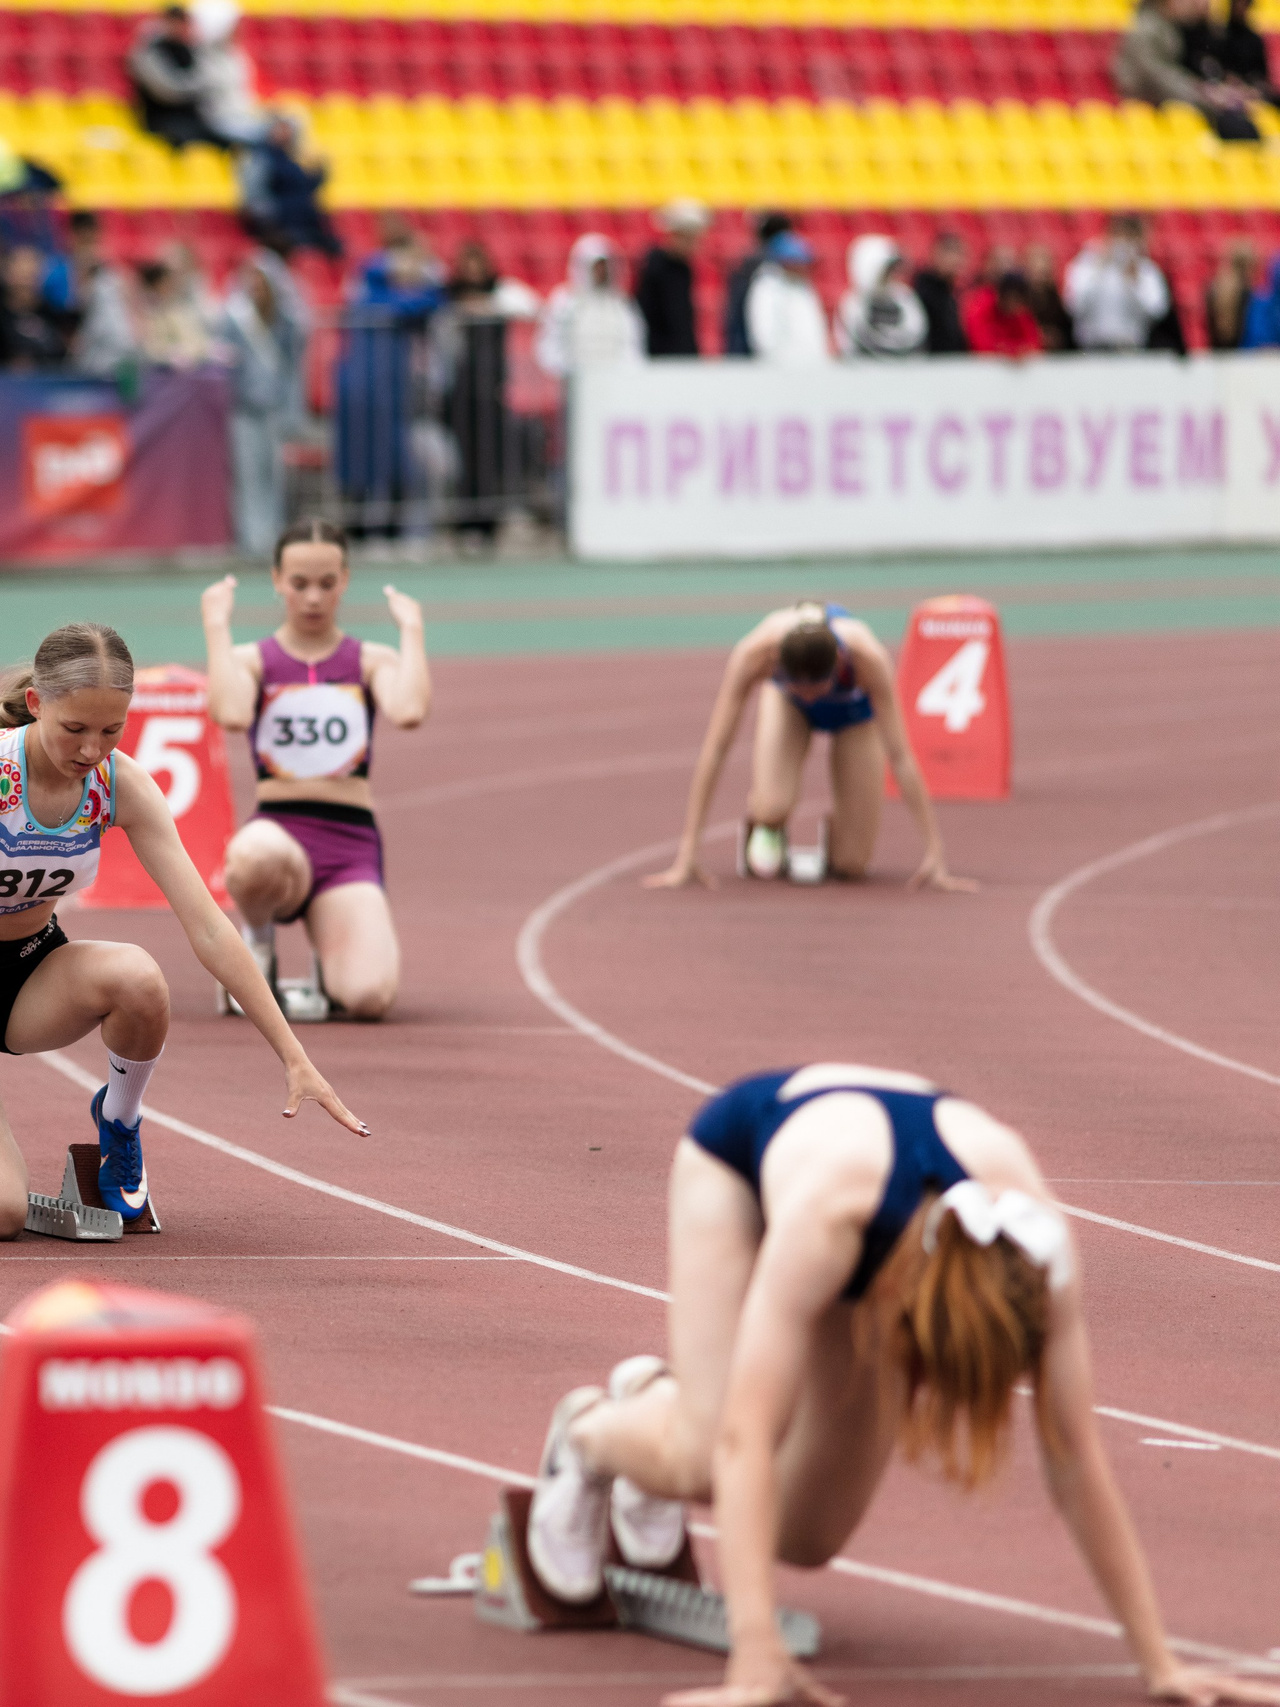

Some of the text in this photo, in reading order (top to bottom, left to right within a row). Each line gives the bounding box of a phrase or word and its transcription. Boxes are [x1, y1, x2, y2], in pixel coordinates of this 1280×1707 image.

[604, 410, 1227, 497] ПРИВЕТСТВУЕМ
[273, 717, 348, 746] 330
[916, 639, 987, 732] 4
[133, 717, 204, 819] 5
[62, 1424, 242, 1696] 8
